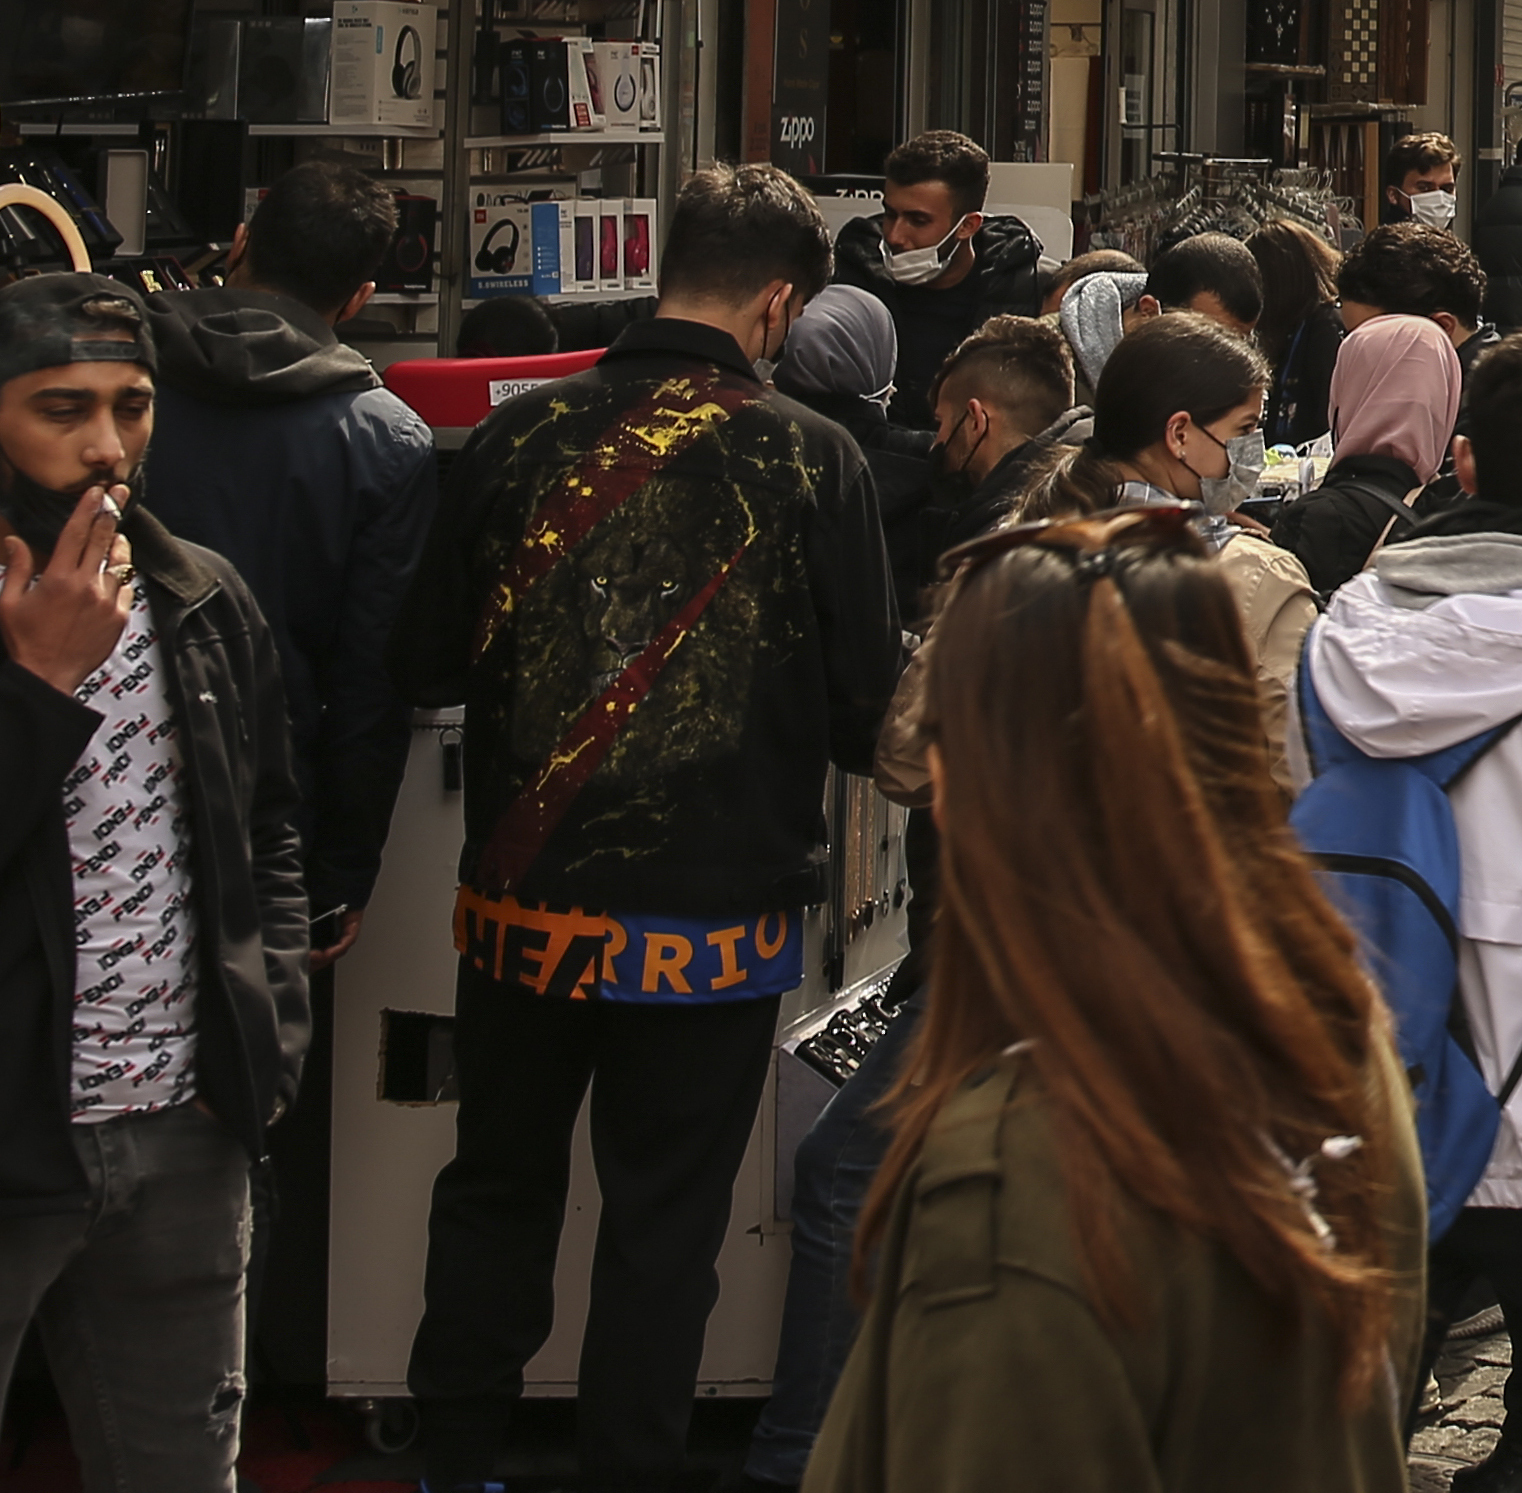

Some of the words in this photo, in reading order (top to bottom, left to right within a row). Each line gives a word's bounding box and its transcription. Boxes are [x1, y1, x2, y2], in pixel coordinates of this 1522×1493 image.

[111, 660, 154, 700] FENDI
[105, 712, 150, 754] FENDI
[92, 799, 136, 841] FENDI
[110, 882, 155, 923] FENDI
[97, 932, 147, 971] FENDI
[78, 1058, 136, 1091] FENDI
